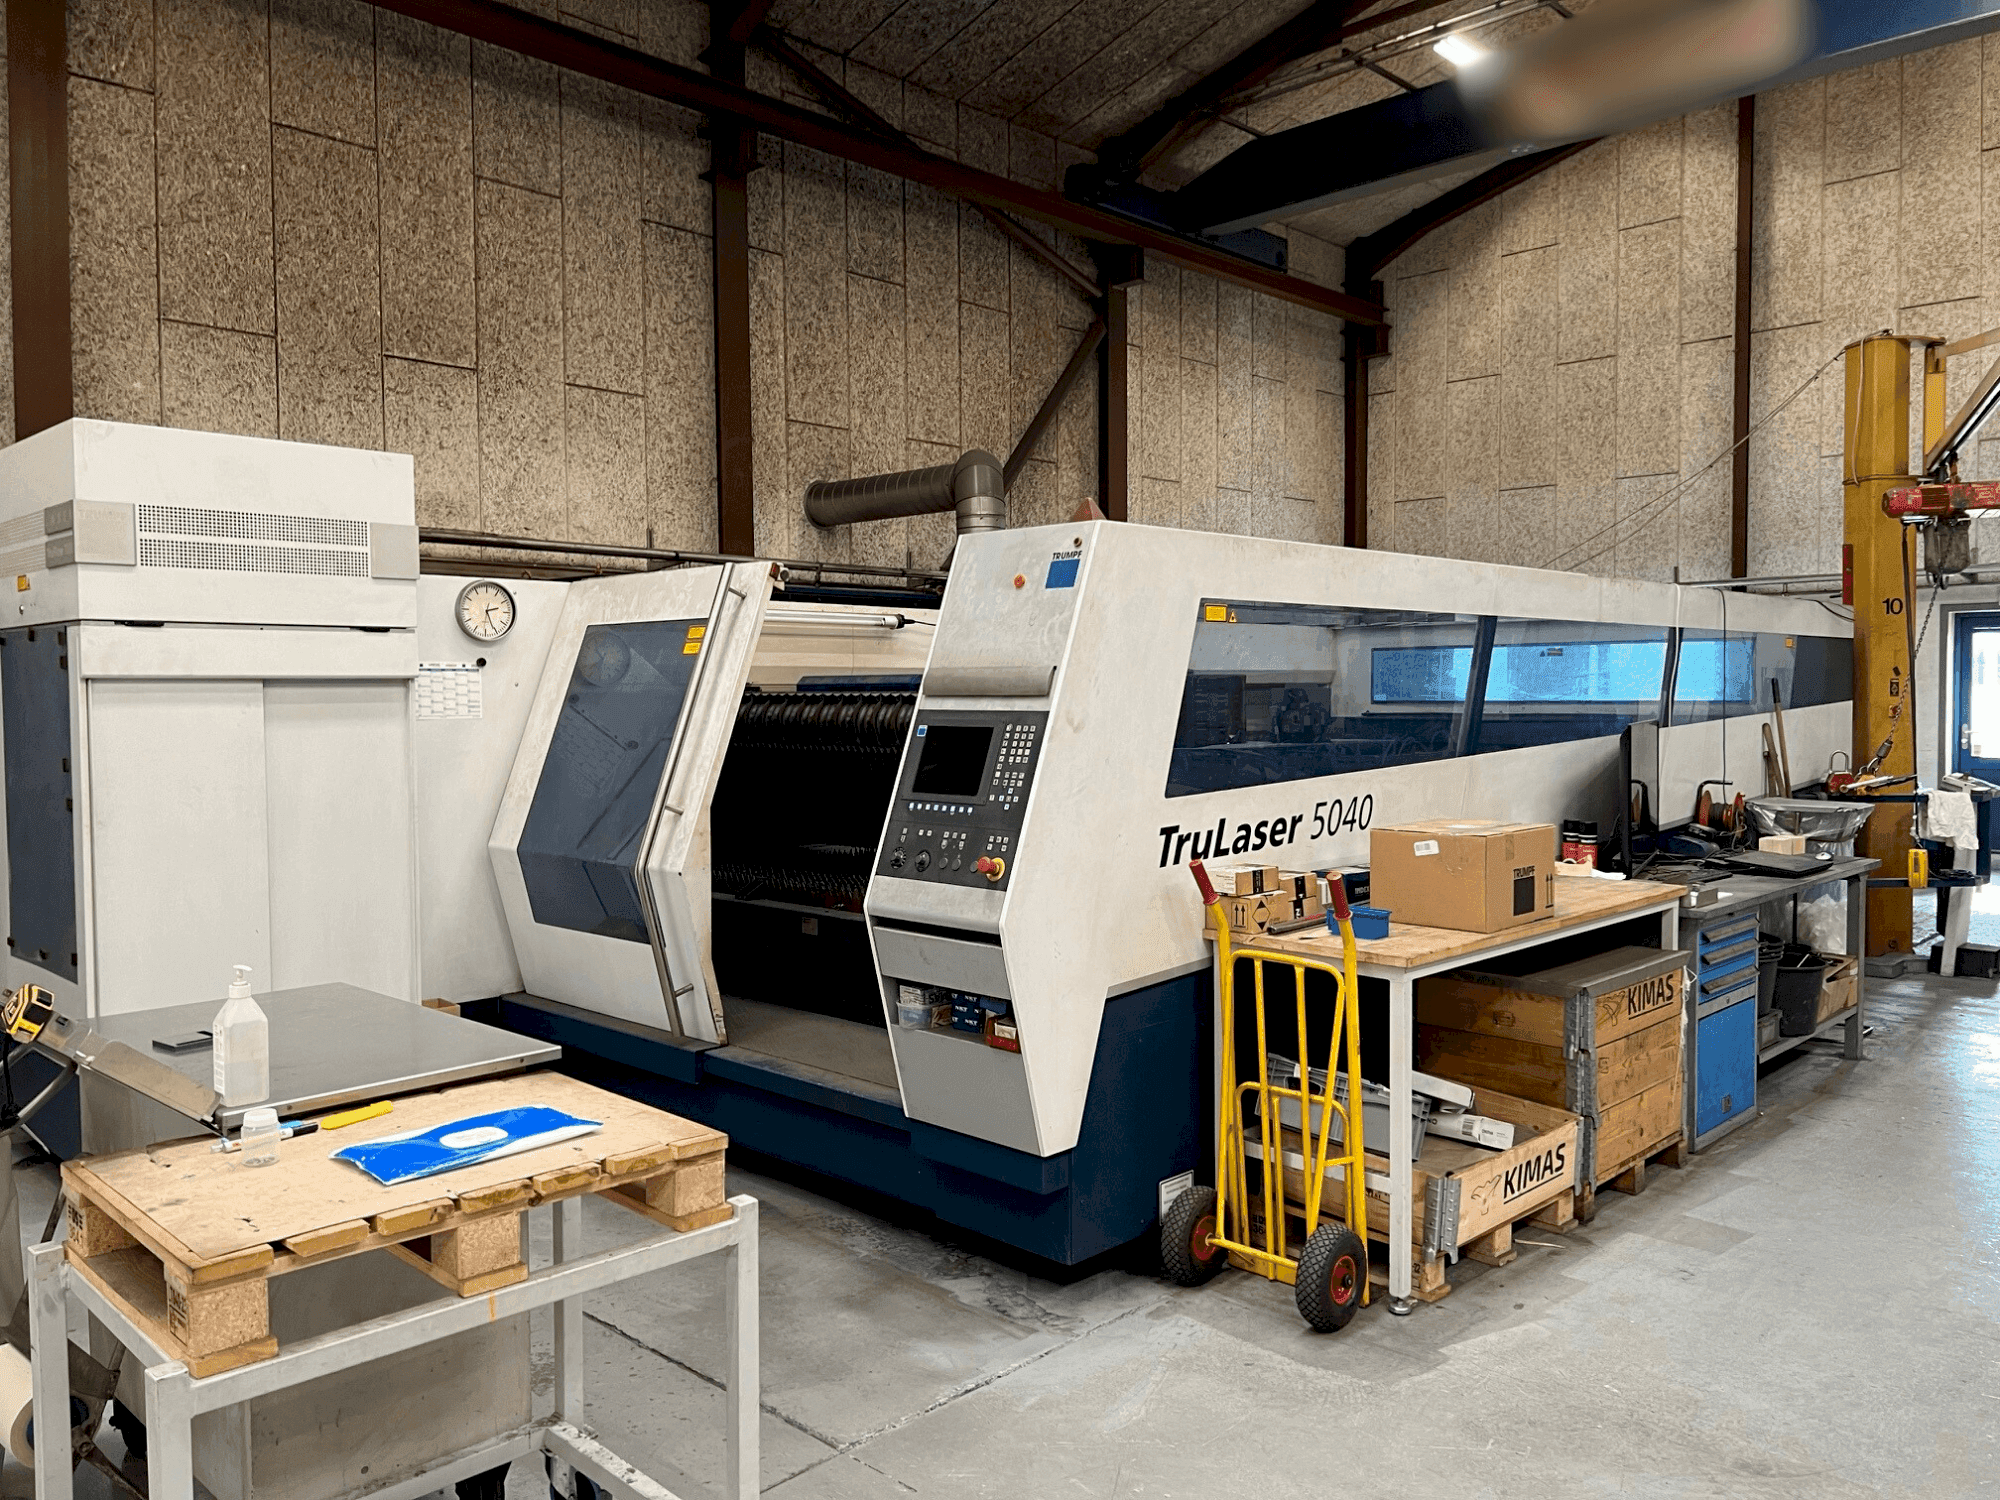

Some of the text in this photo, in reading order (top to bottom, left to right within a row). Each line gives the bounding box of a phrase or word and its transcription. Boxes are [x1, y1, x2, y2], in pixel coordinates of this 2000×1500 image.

[1052, 551, 1082, 559] TRUMPF
[1882, 597, 1903, 615] 10
[1159, 793, 1373, 869] TruLaser 5040
[1512, 865, 1536, 879] TRUMPF
[1627, 973, 1674, 1016] KIMAS
[1503, 1142, 1566, 1199] KIMAS
